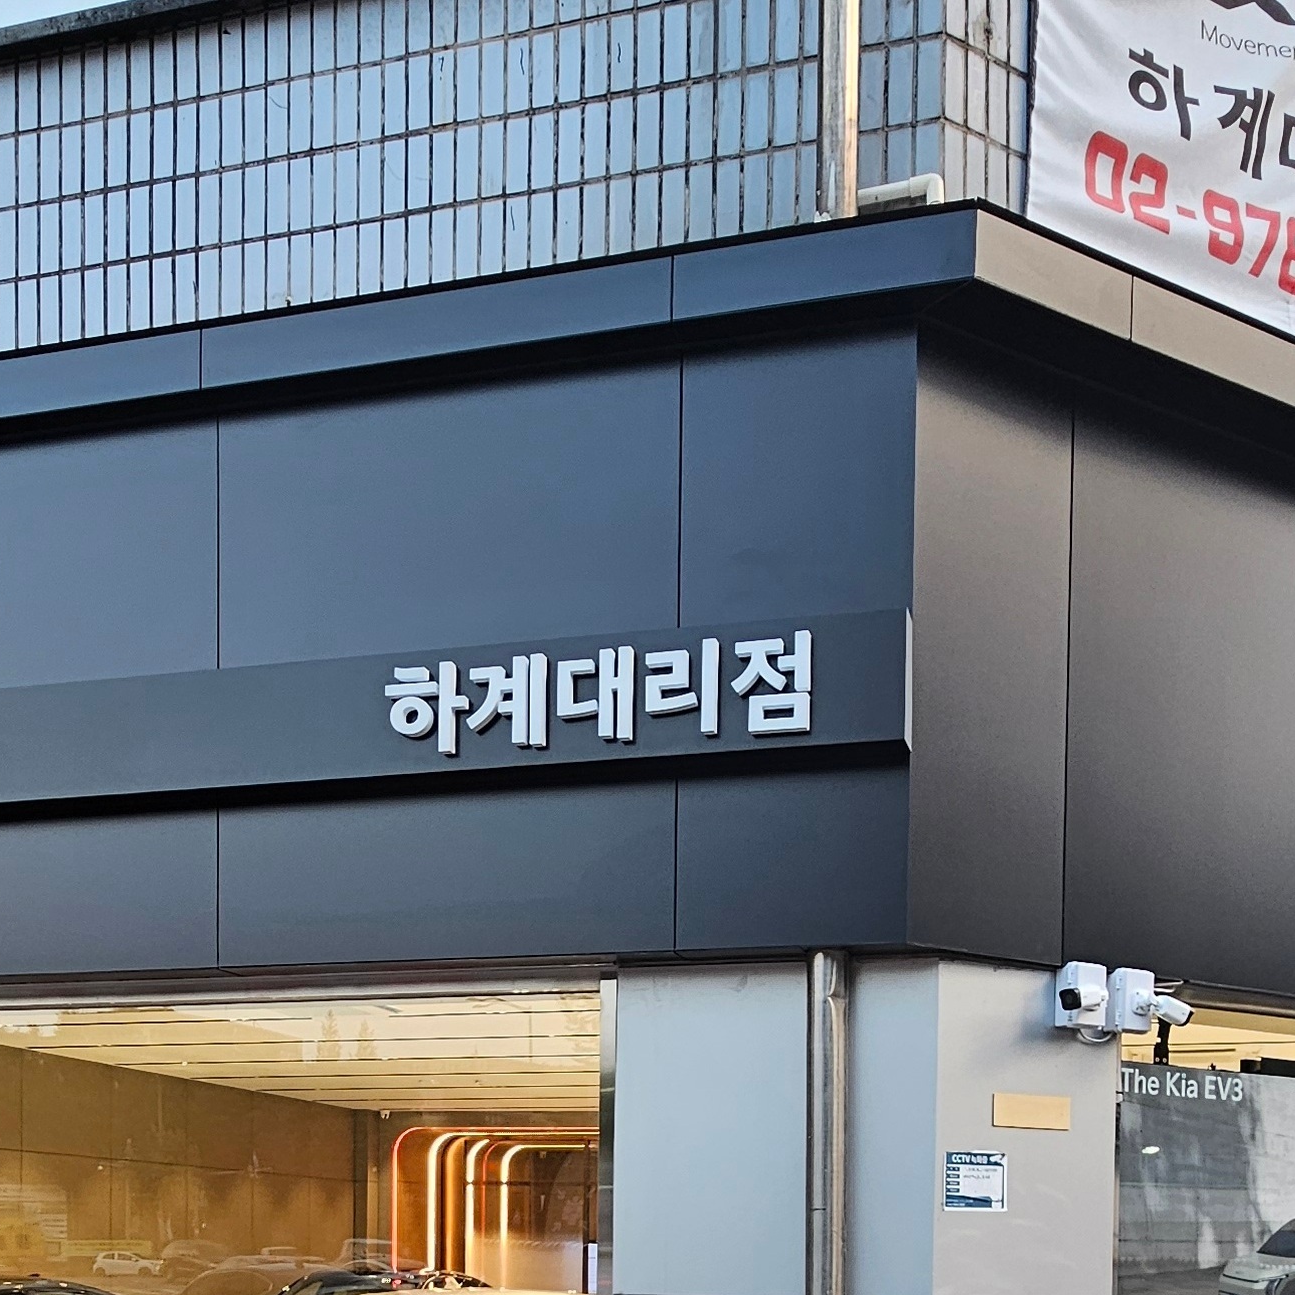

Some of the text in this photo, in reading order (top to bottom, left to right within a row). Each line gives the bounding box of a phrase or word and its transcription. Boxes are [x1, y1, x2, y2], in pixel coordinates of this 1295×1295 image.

[385, 630, 812, 755] 하계대리점
[1121, 1067, 1243, 1102] The Kia EV3
[952, 1154, 971, 1163] CCTV
